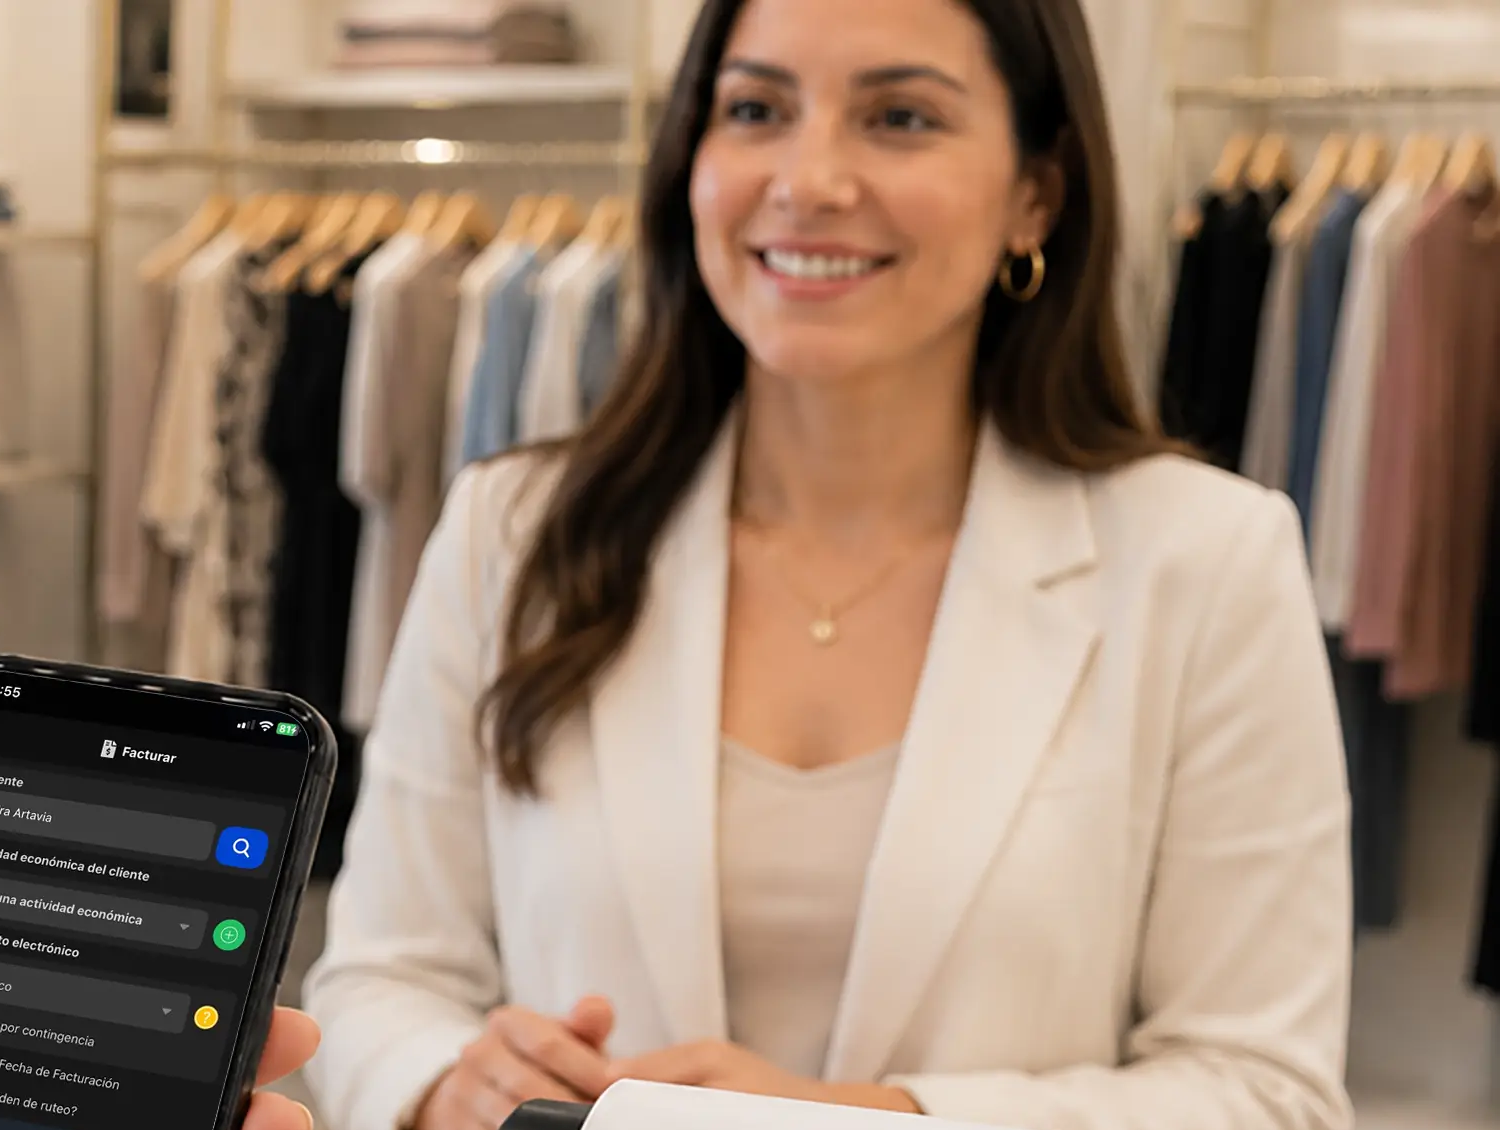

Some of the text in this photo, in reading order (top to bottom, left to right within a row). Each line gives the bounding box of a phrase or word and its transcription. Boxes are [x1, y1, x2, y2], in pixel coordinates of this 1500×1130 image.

[122, 745, 177, 765] Facturar
[13, 807, 52, 824] Artavia
[20, 851, 86, 872] económica
[87, 860, 108, 874] del
[109, 863, 150, 881] cliente
[19, 895, 74, 916] actividad
[77, 903, 143, 926] económica
[12, 936, 80, 959] electrónico
[0, 1022, 20, 1035] por
[22, 1023, 95, 1047] contingencia
[35, 1066, 50, 1078] de
[53, 1068, 120, 1090] Facturación
[24, 1098, 38, 1109] de
[40, 1100, 78, 1116] ruteo?
